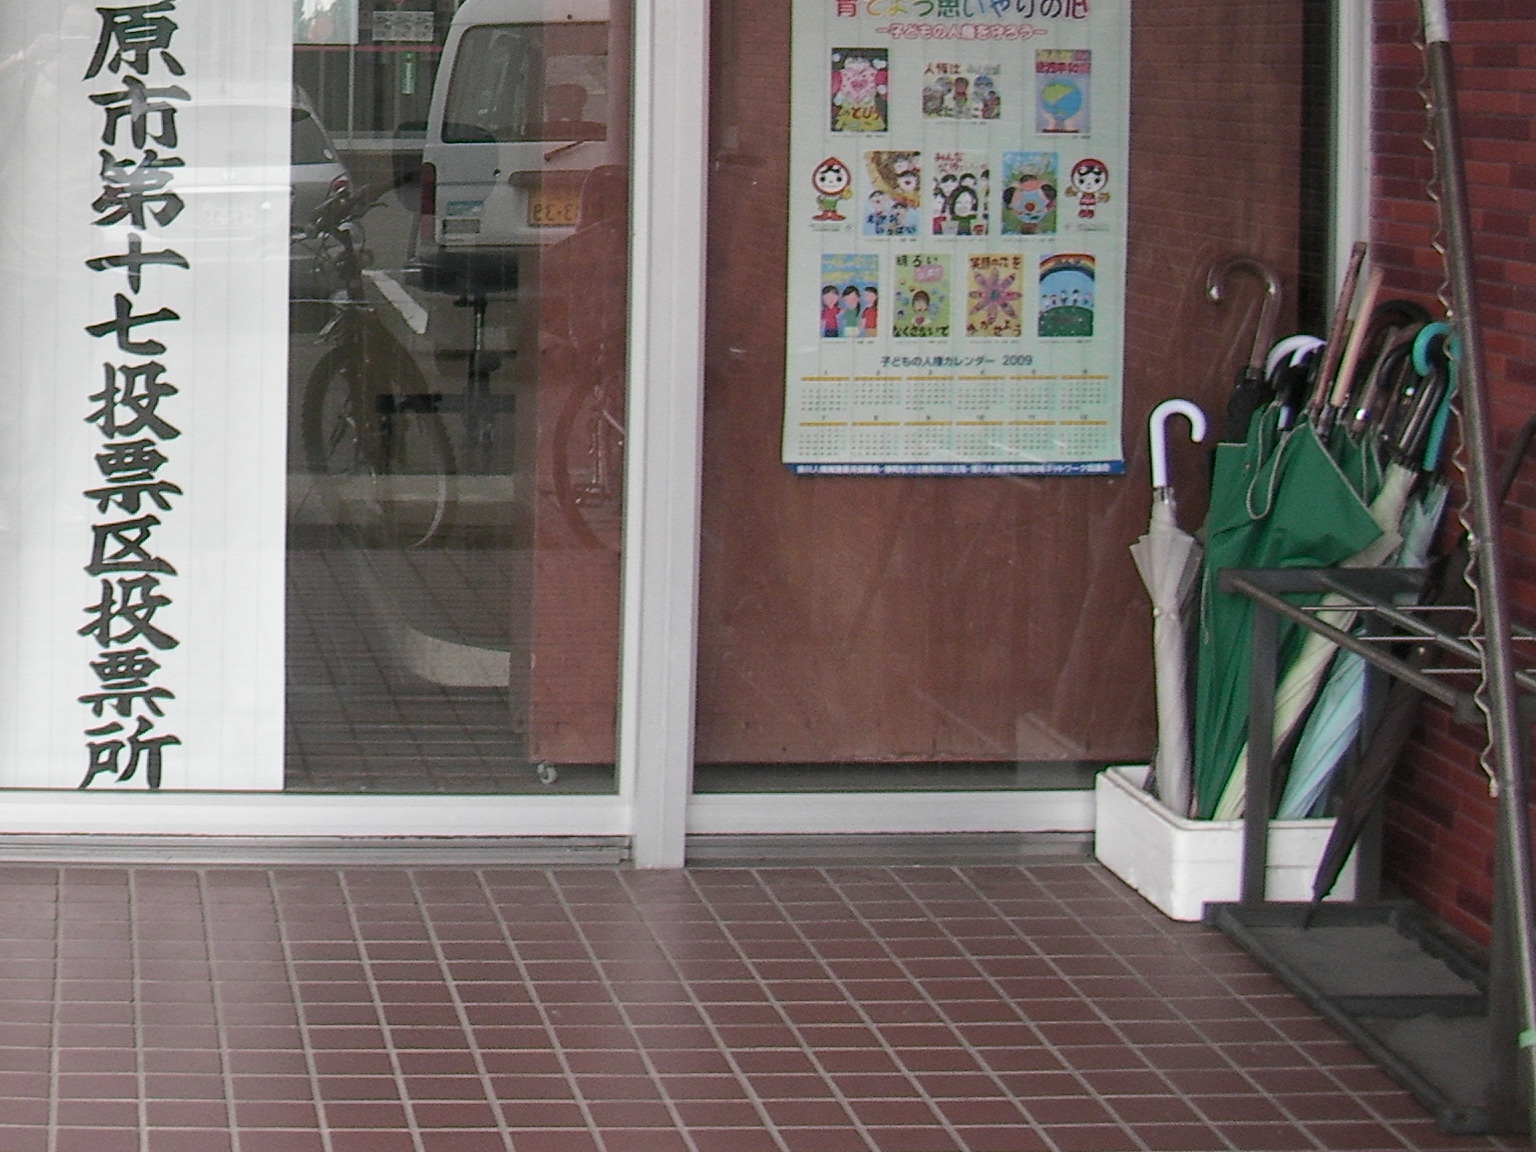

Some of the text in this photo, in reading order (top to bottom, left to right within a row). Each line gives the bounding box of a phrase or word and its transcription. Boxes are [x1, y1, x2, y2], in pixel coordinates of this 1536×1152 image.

[880, 355, 1034, 368] 子どもの人権カレンダー 2009
